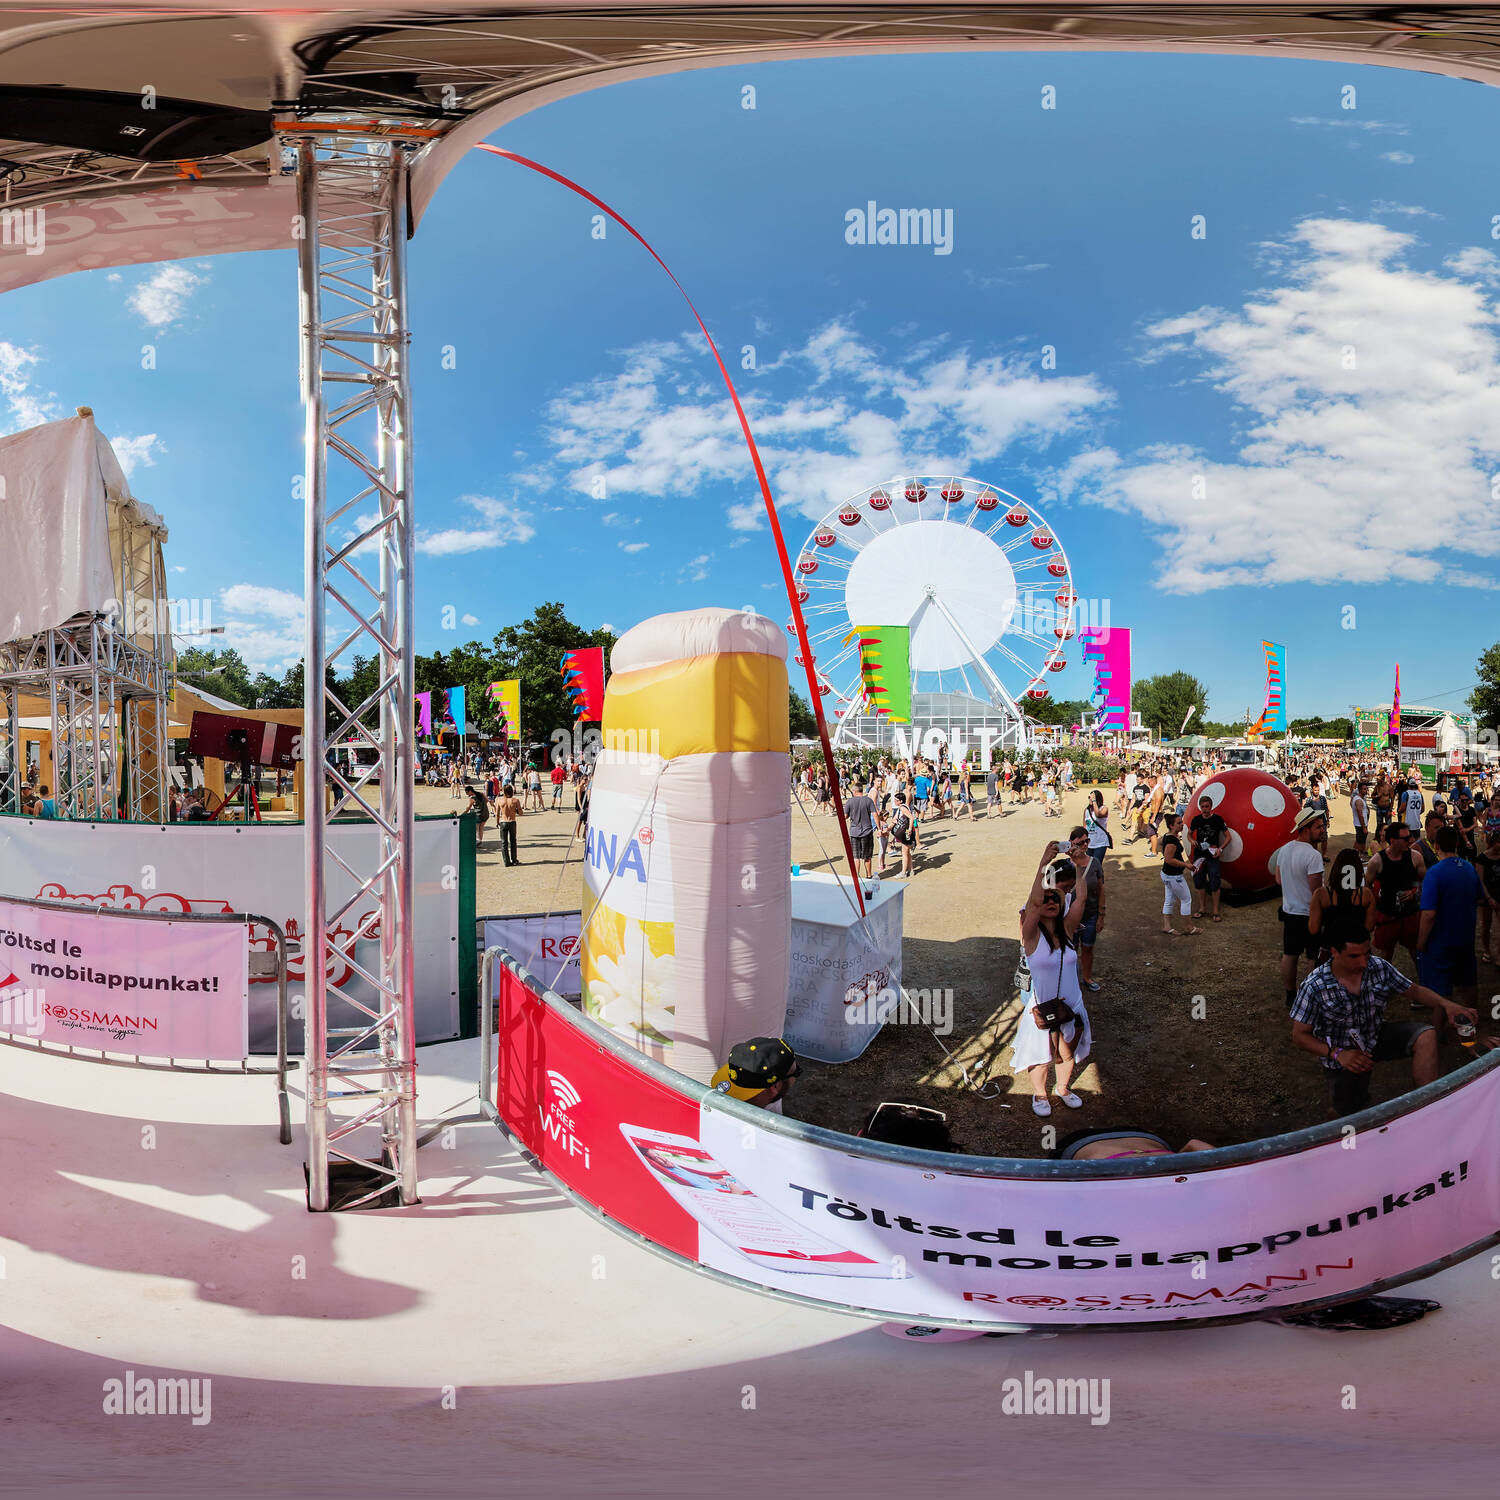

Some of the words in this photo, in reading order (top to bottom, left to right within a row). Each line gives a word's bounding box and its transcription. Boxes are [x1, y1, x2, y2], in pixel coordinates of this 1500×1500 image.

[896, 727, 998, 773] VOLT
[1410, 800, 1421, 810] 30
[62, 941, 82, 958] le
[30, 963, 219, 993] mobilappunkat!
[41, 1003, 158, 1031] ROSSMANN
[538, 1104, 590, 1170] WiFi
[551, 1103, 576, 1133] FREE
[788, 1183, 1015, 1246] Töltsd
[1045, 1230, 1120, 1248] le
[923, 1160, 1470, 1271] mobilappunkat!
[962, 1257, 1353, 1309] ROSSMANN
